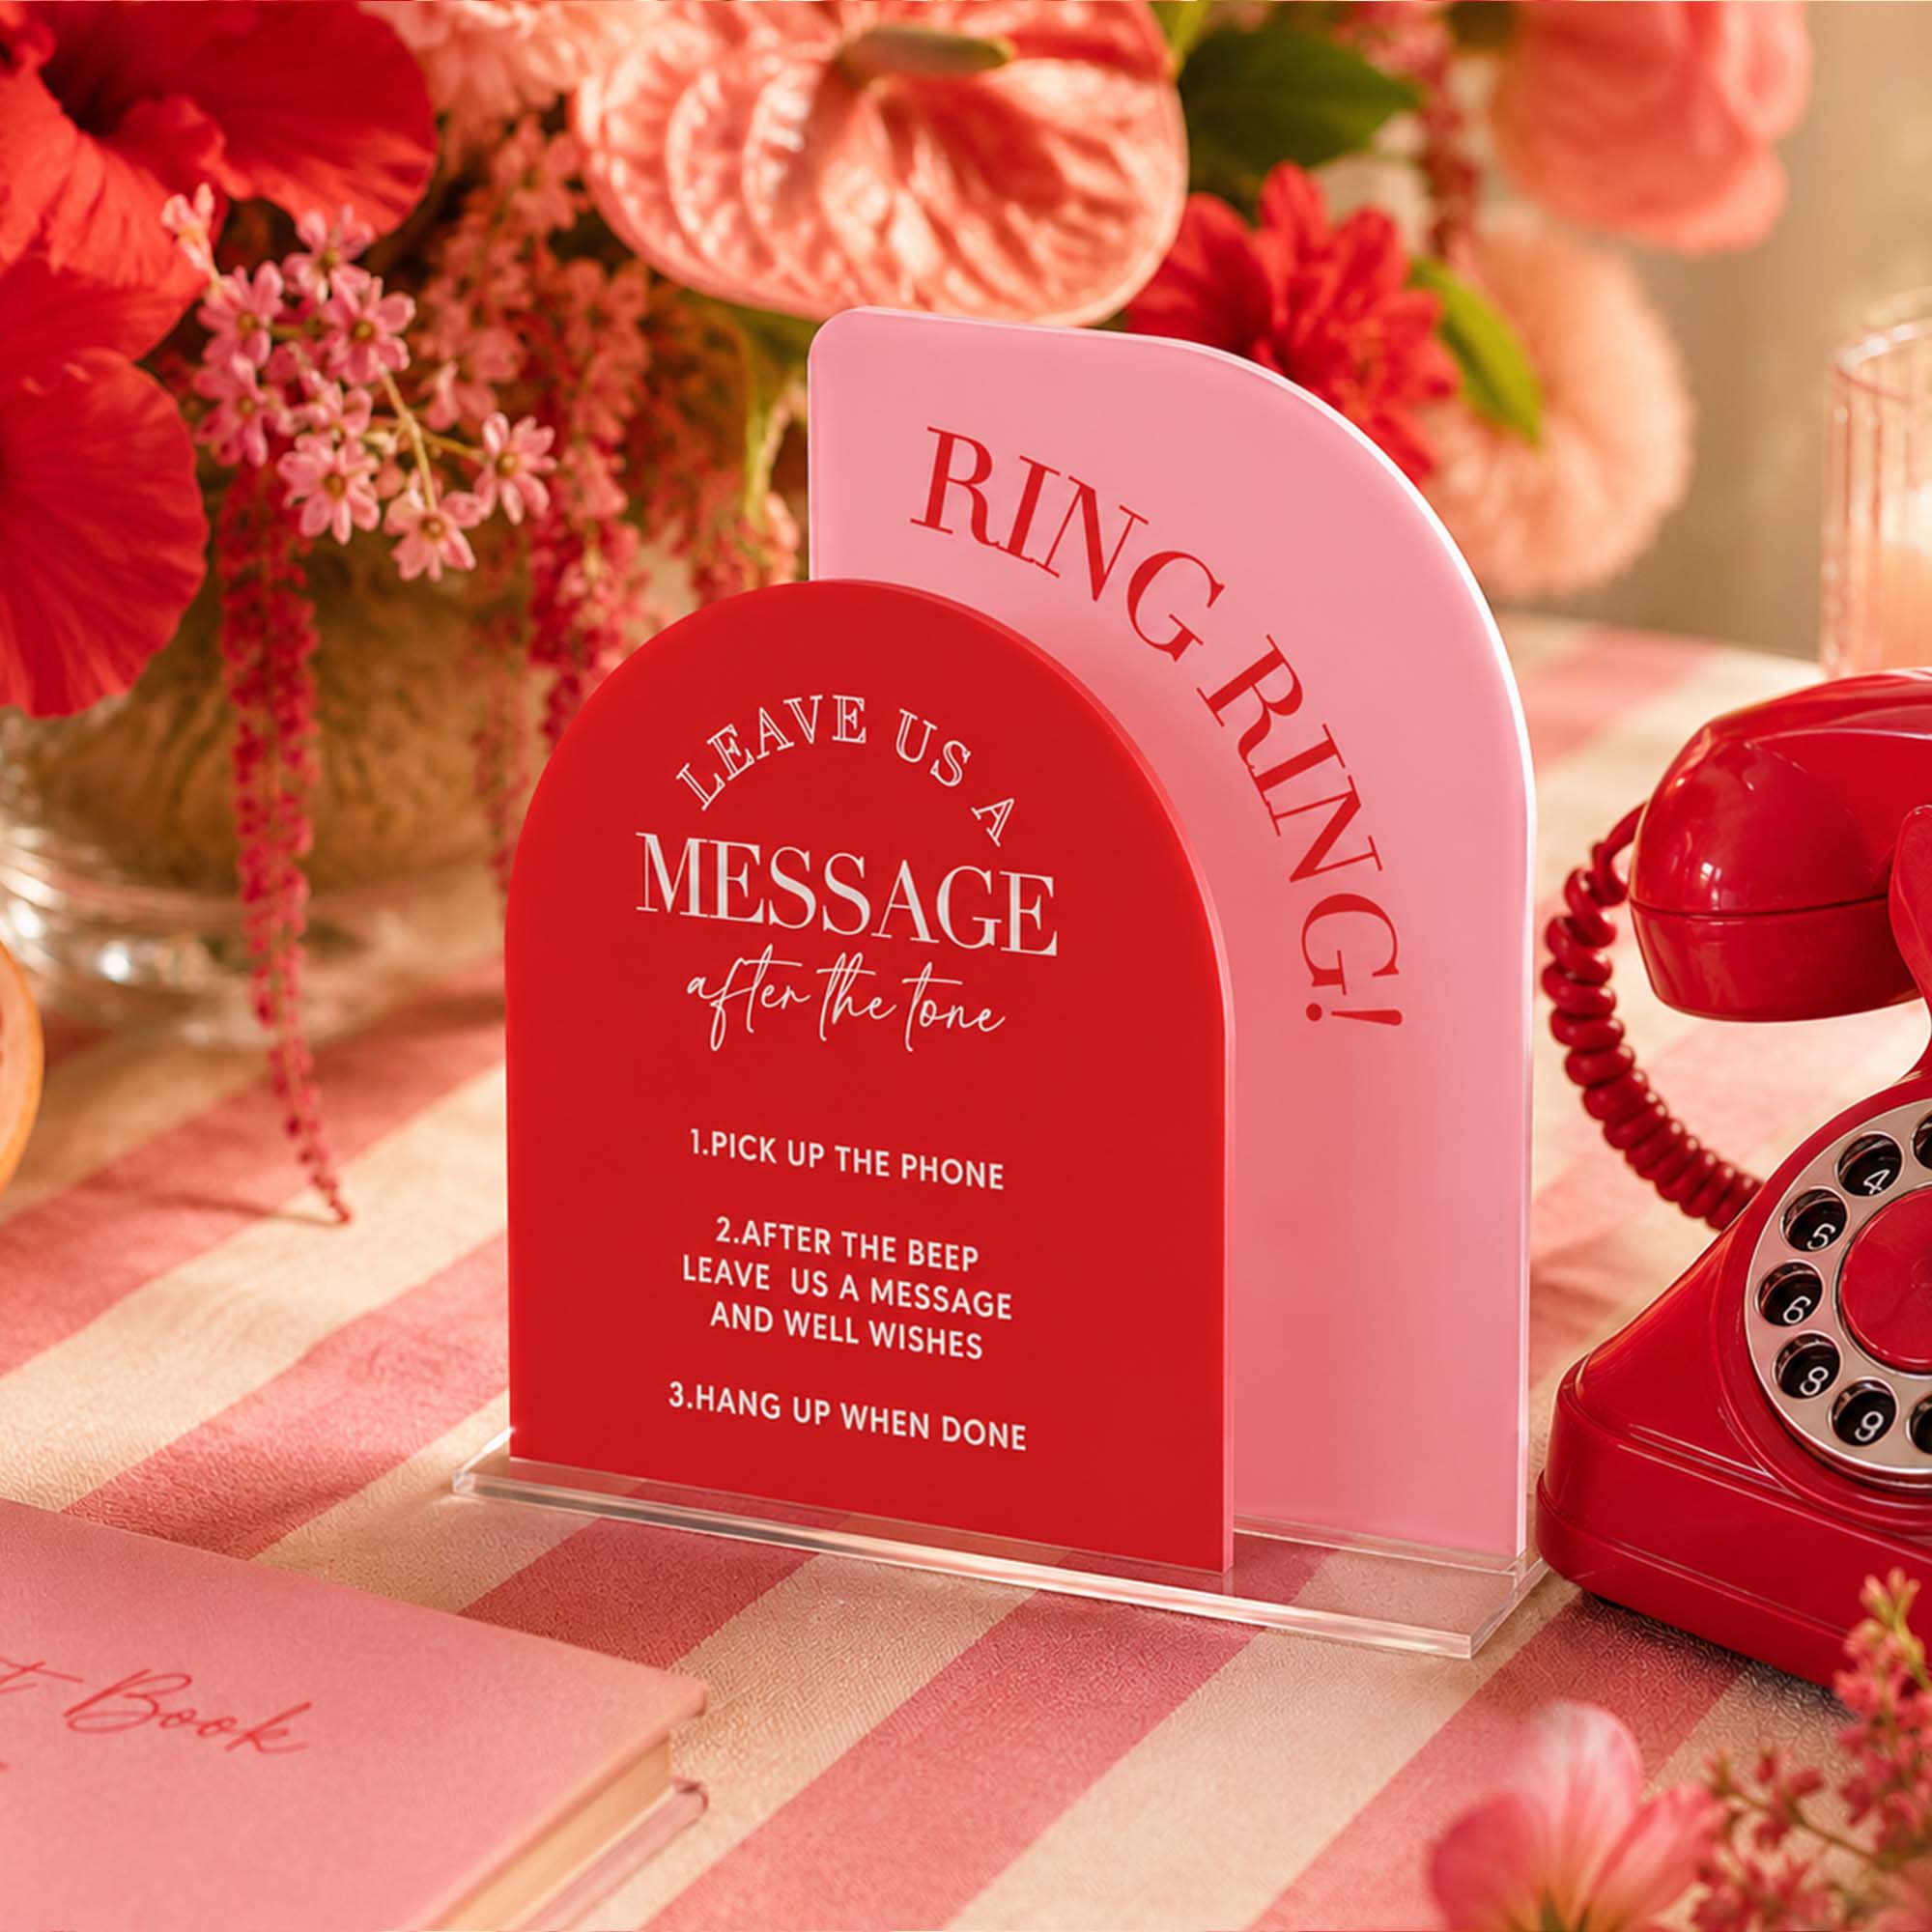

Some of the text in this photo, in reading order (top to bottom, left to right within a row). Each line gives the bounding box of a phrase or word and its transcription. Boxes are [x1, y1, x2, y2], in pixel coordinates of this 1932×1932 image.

[910, 426, 1403, 1026] RING RING!
[676, 695, 1014, 846] LEAVE US A
[636, 832, 1057, 956] MESSAGE
[687, 944, 1006, 1051] after the tone
[690, 1128, 1004, 1190] 1.PICK UP THE PHONE
[716, 1216, 979, 1271] 2.AFTER THE BEEP
[1806, 1223, 1836, 1251] 5
[682, 1255, 1012, 1320] LEAVE US A MESSAGE
[1782, 1295, 1812, 1324] 6
[710, 1301, 983, 1360] AND WELL WISHES
[1800, 1367, 1829, 1396] 8
[668, 1381, 1027, 1451] 3.HANG UP WHEN DONE
[1855, 1410, 1885, 1443] 9
[63, 1668, 312, 1753] Book
